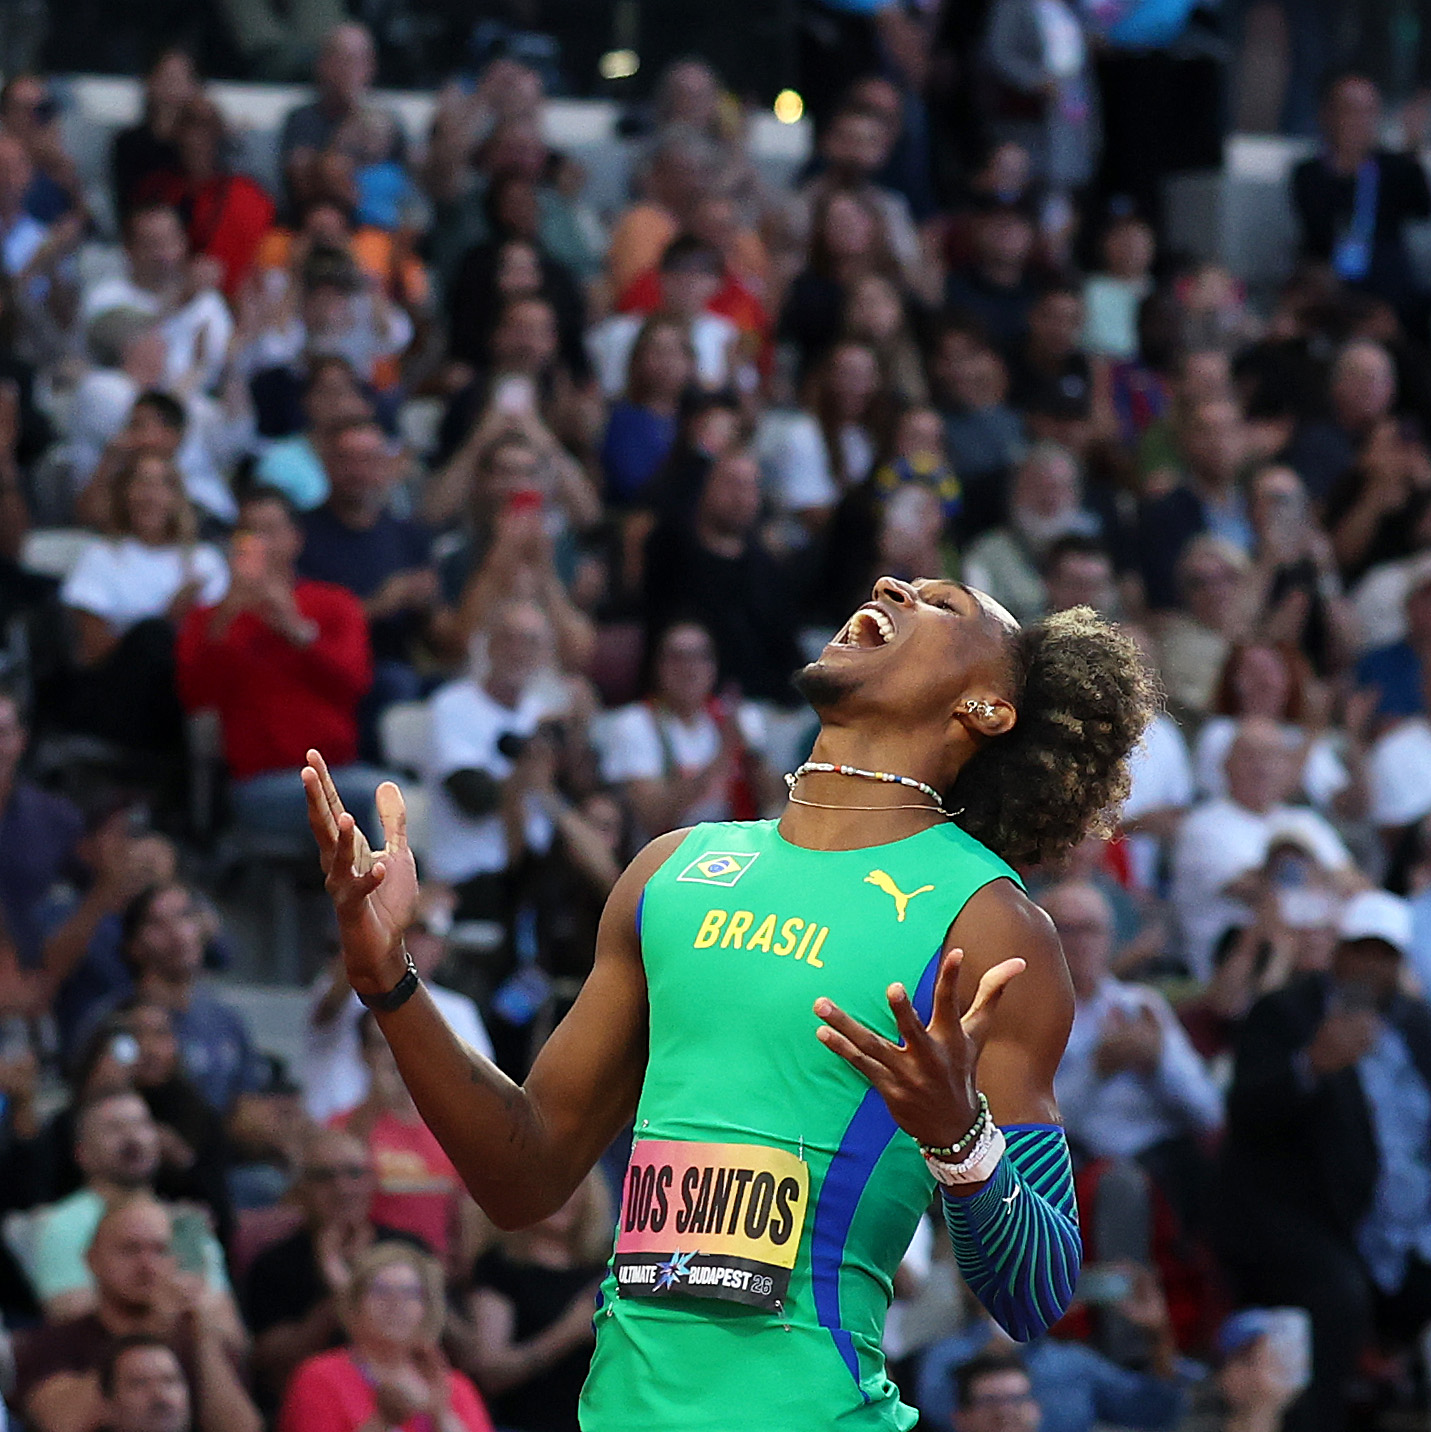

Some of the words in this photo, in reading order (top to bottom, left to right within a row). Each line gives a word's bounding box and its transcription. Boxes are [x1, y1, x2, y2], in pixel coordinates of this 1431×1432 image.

[693, 909, 830, 968] BRASIL
[624, 1164, 673, 1234] DOS
[676, 1166, 799, 1246] SANTOS
[618, 1265, 658, 1284] ULTIMATE
[688, 1266, 752, 1291] BUDAPEST
[750, 1274, 773, 1295] 26
